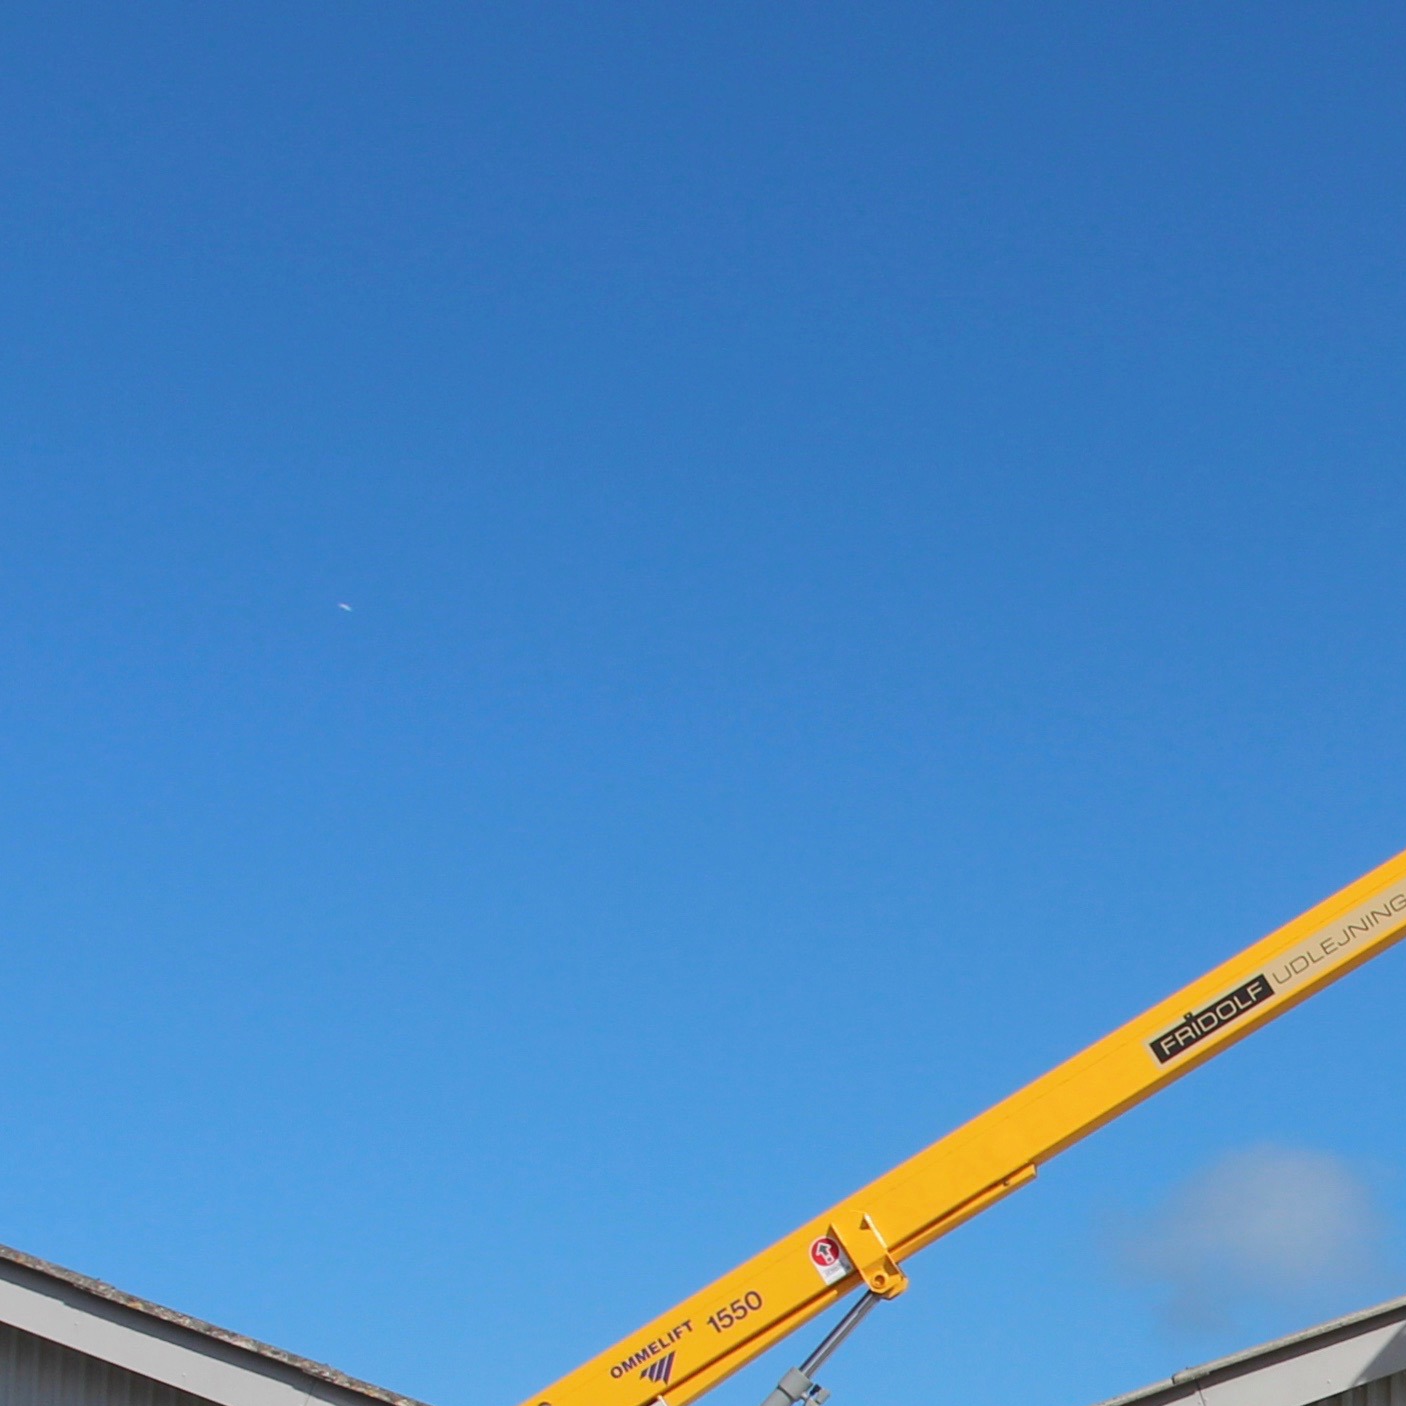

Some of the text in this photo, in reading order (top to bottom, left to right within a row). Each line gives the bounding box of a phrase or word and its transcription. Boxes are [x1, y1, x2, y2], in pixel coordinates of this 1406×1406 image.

[1159, 980, 1265, 1056] FRIDOLF
[610, 1290, 763, 1379] OMMELIFT 1550
